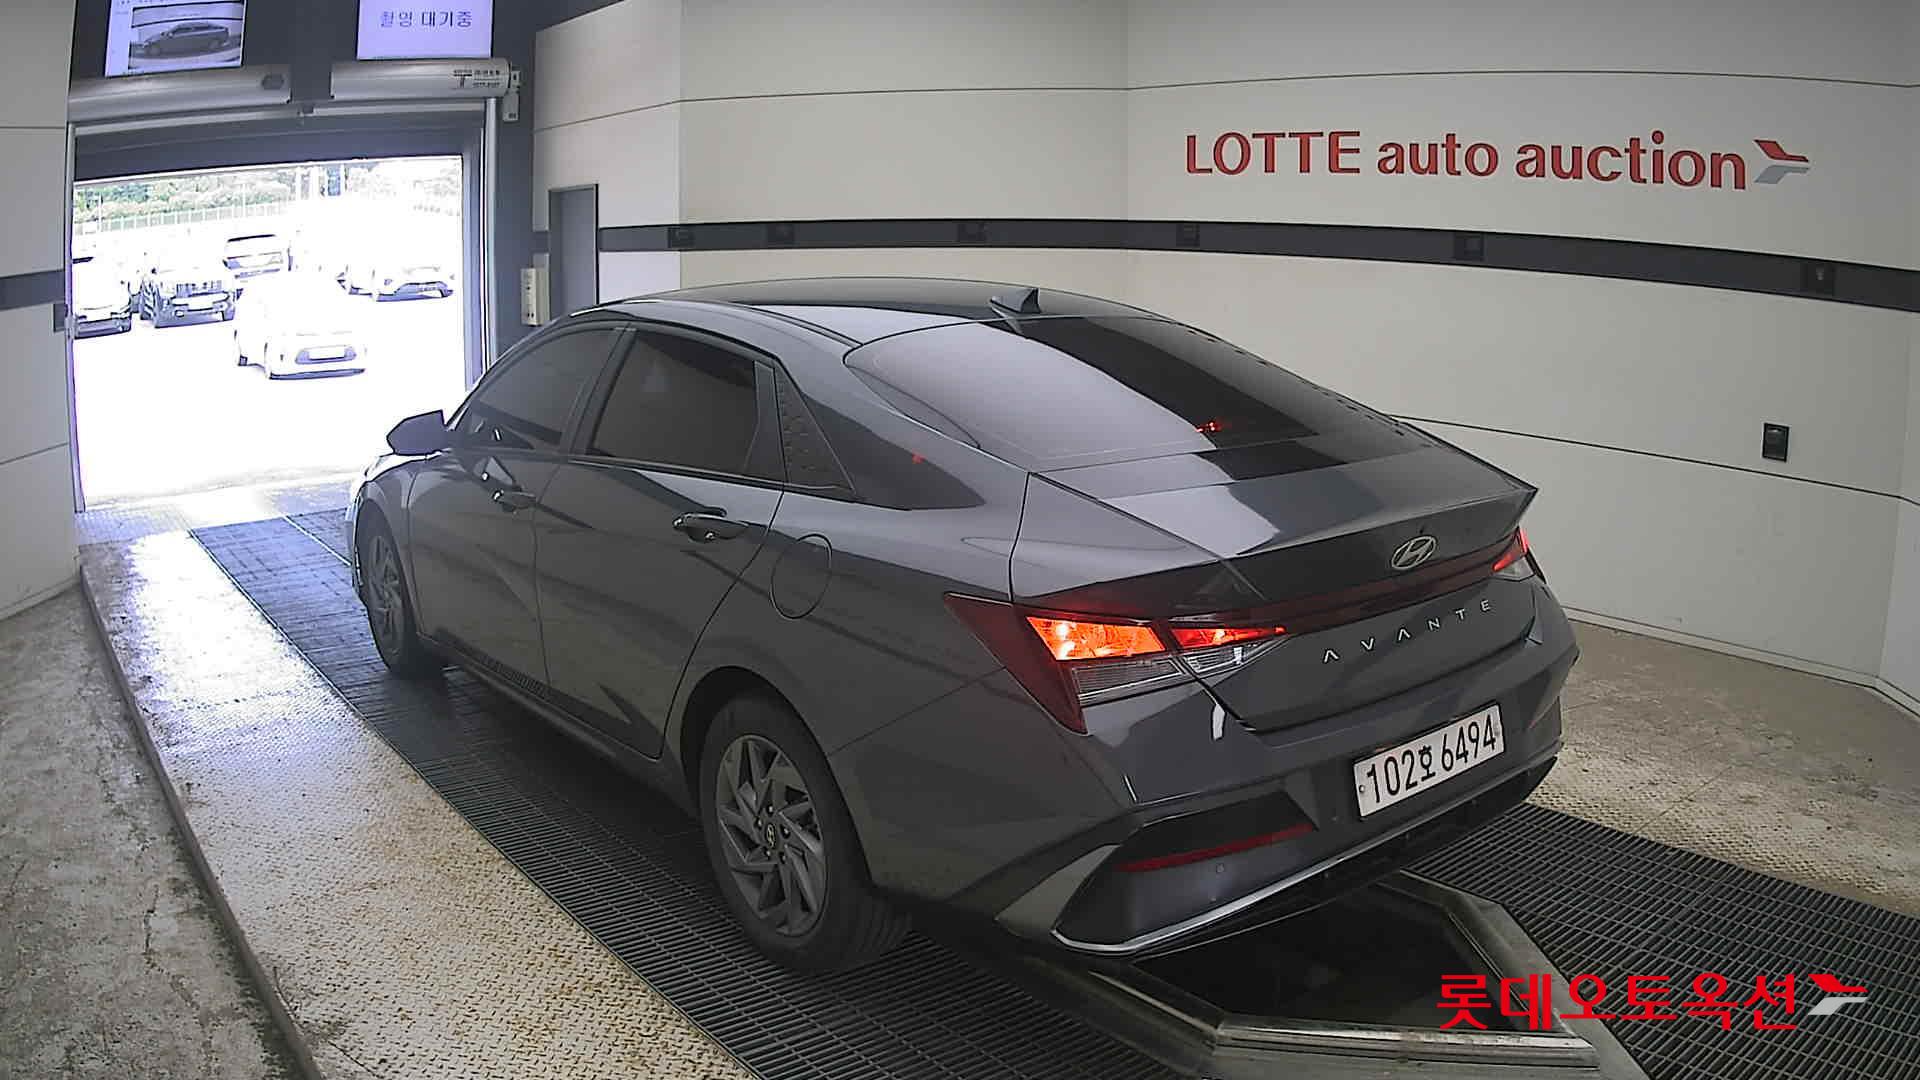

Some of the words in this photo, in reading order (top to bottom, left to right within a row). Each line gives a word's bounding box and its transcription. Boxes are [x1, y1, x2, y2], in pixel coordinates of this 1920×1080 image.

[421, 11, 473, 28] 대기중
[1186, 131, 1361, 175] LOTTE
[1377, 133, 1499, 177] auto
[1515, 130, 1746, 190] auction
[1323, 599, 1491, 663] AVANTE
[1441, 714, 1496, 772] 6494
